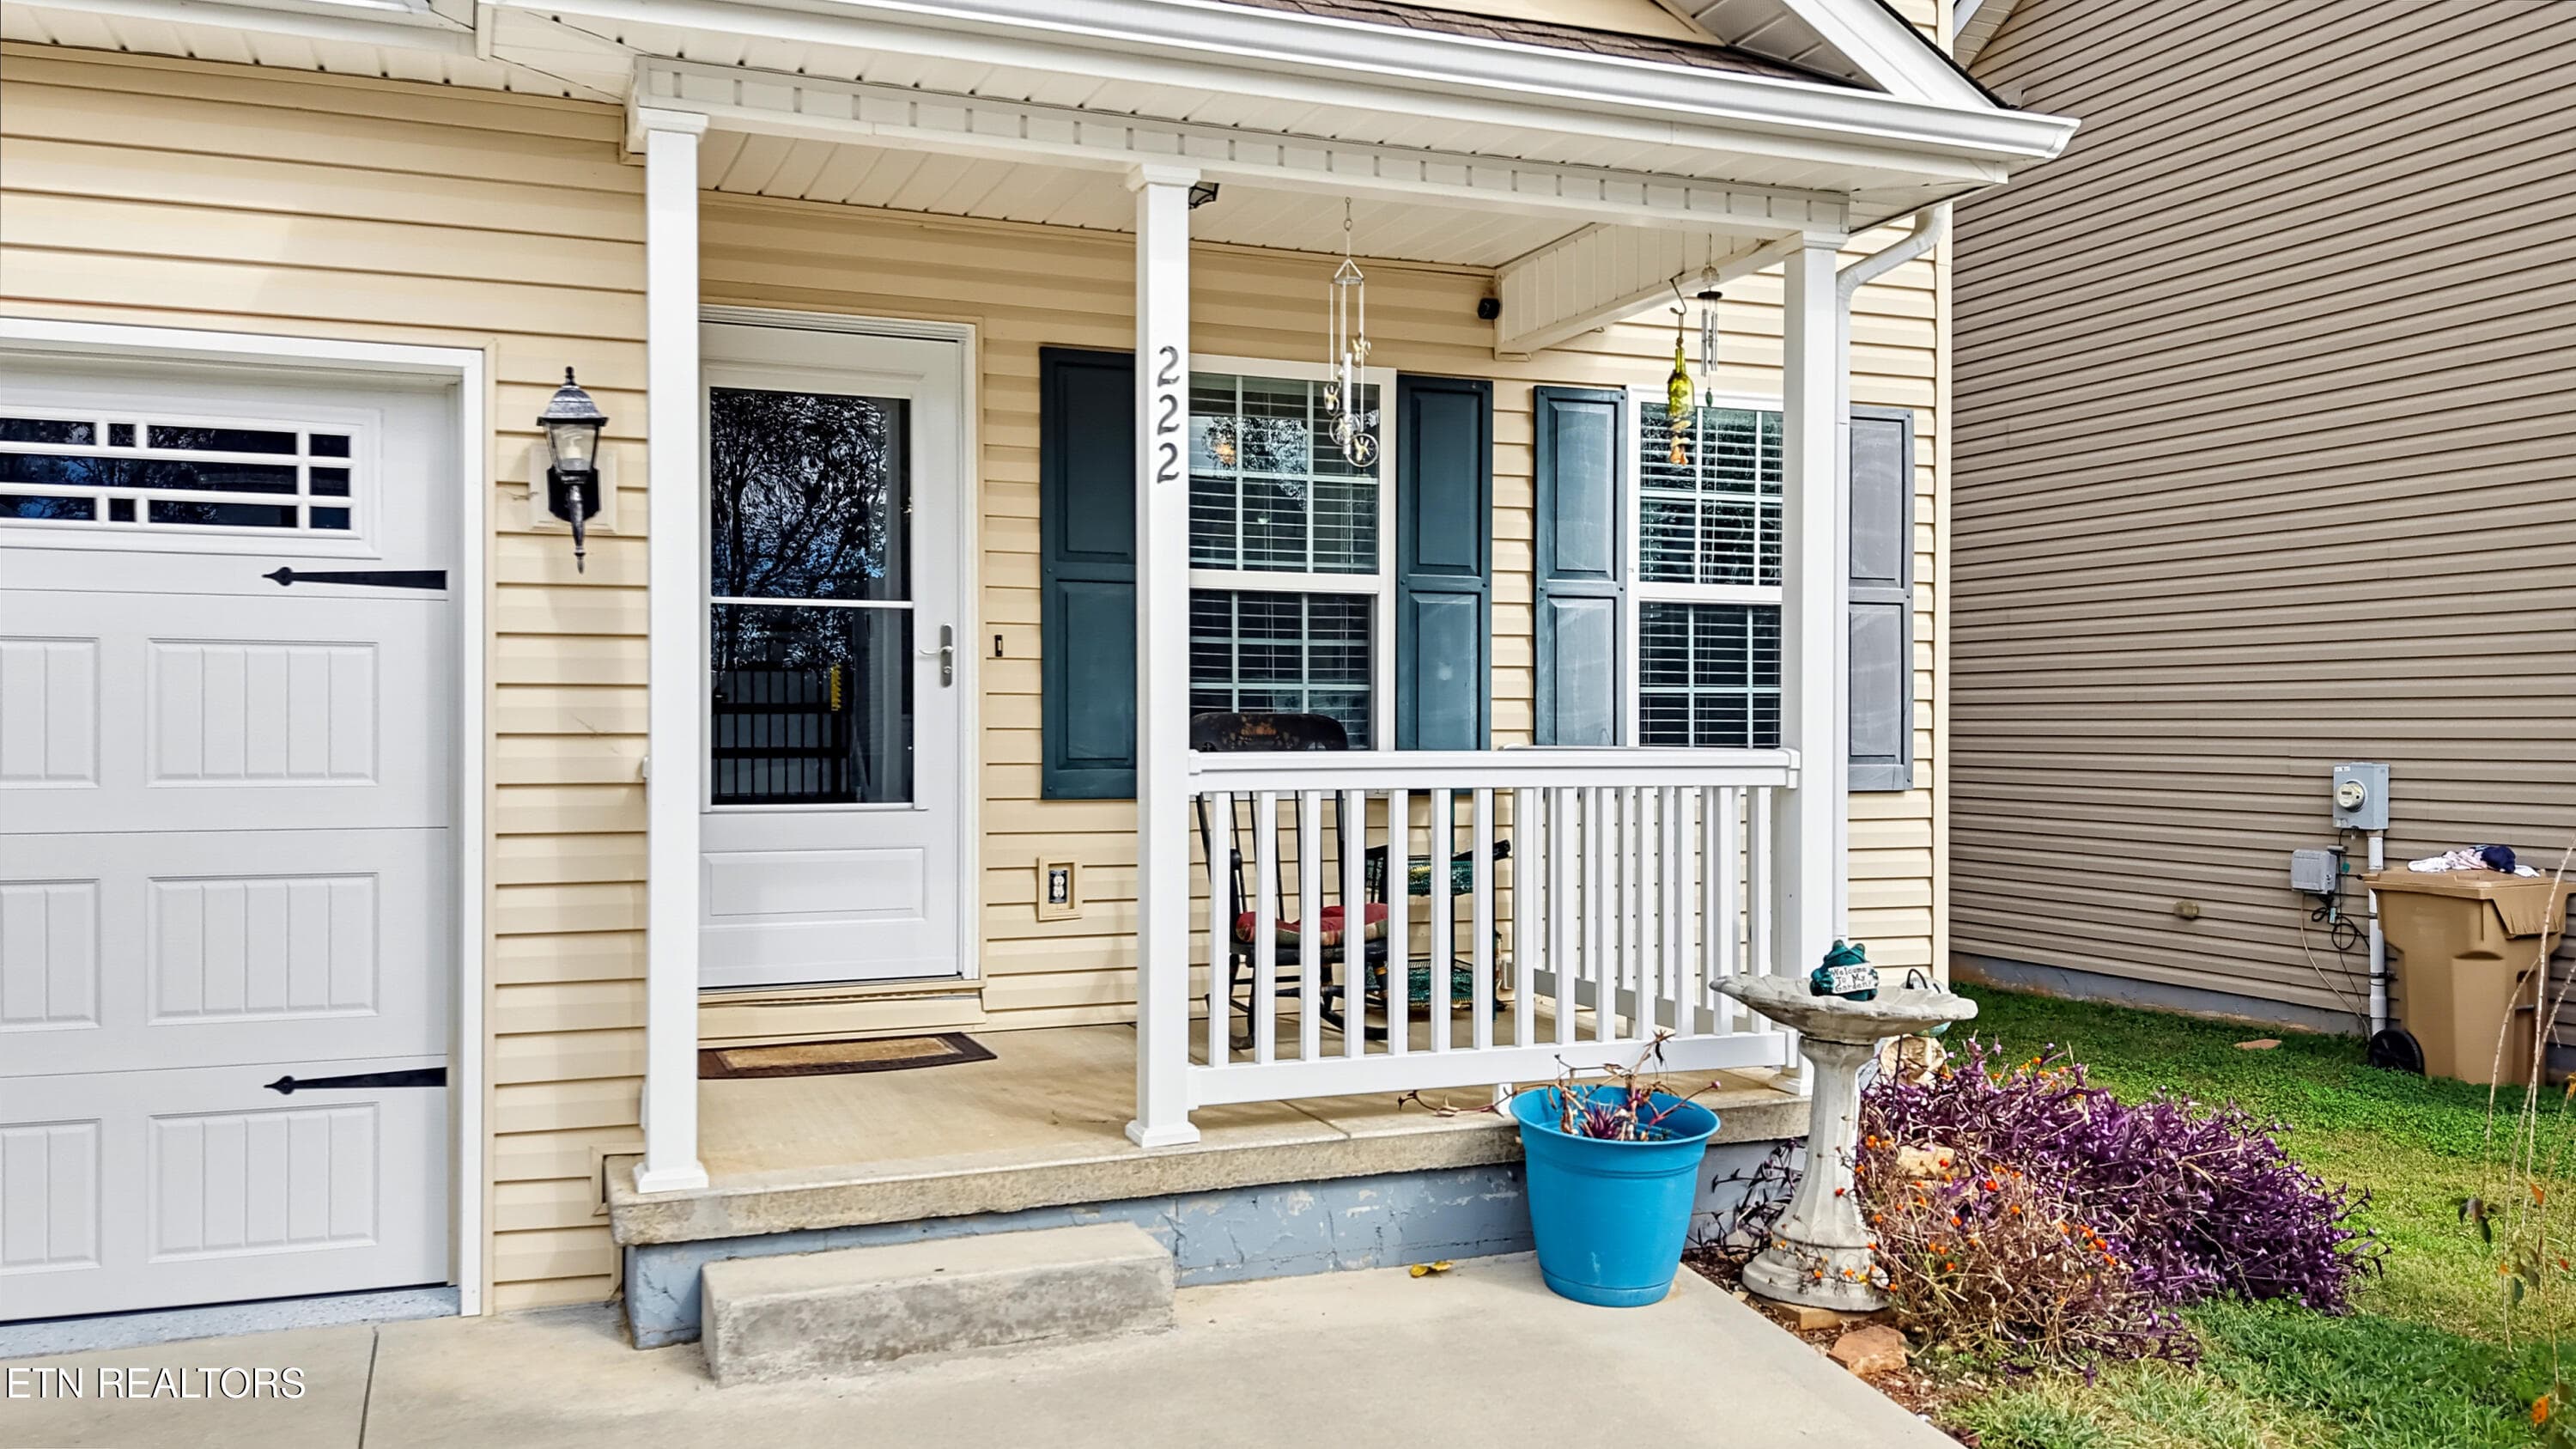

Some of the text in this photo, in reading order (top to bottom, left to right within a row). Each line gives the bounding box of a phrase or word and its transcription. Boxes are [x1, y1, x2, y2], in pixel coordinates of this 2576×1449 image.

[1157, 345, 1180, 484] 222
[1832, 967, 1867, 976] Welcome
[1836, 973, 1865, 985] To My
